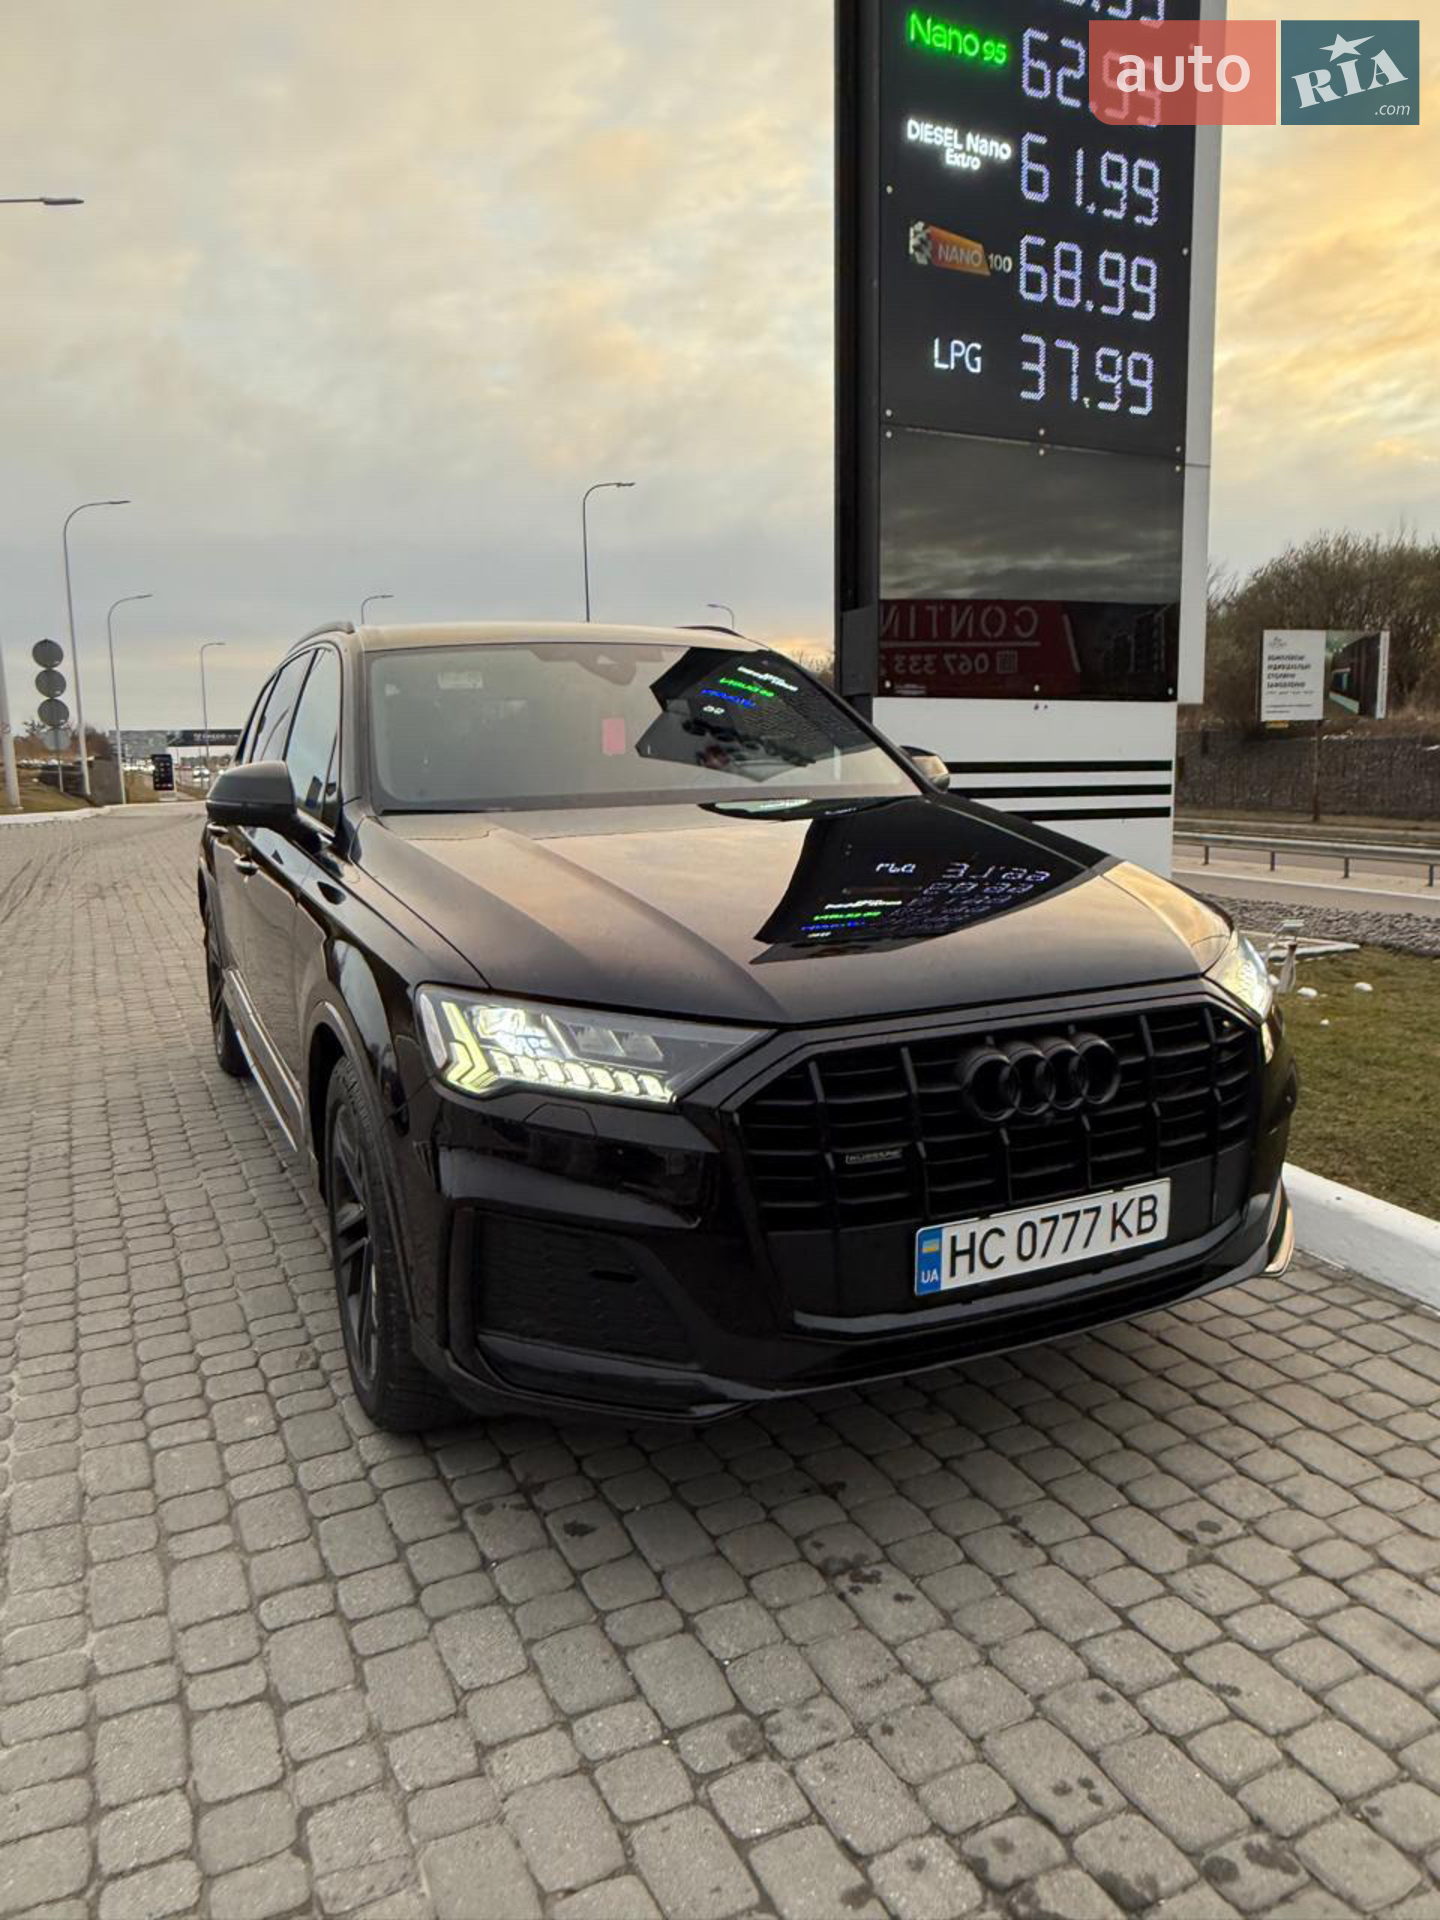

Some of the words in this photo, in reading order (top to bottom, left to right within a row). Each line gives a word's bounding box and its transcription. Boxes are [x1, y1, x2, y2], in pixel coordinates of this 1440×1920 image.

[909, 12, 979, 57] Nano
[983, 41, 1007, 65] 95
[906, 118, 963, 151] DIESEL
[965, 131, 1012, 160] Nano
[1020, 132, 1160, 227] 61.99
[937, 243, 983, 267] NANO
[987, 253, 1012, 274] 100
[1019, 234, 1157, 321] 68.99
[933, 337, 982, 374] LPG
[1020, 333, 1154, 416] 37.99
[949, 1227, 1006, 1278] HC
[1016, 1205, 1102, 1262] 0777
[1110, 1194, 1159, 1243] KB
[921, 1269, 939, 1284] UA
